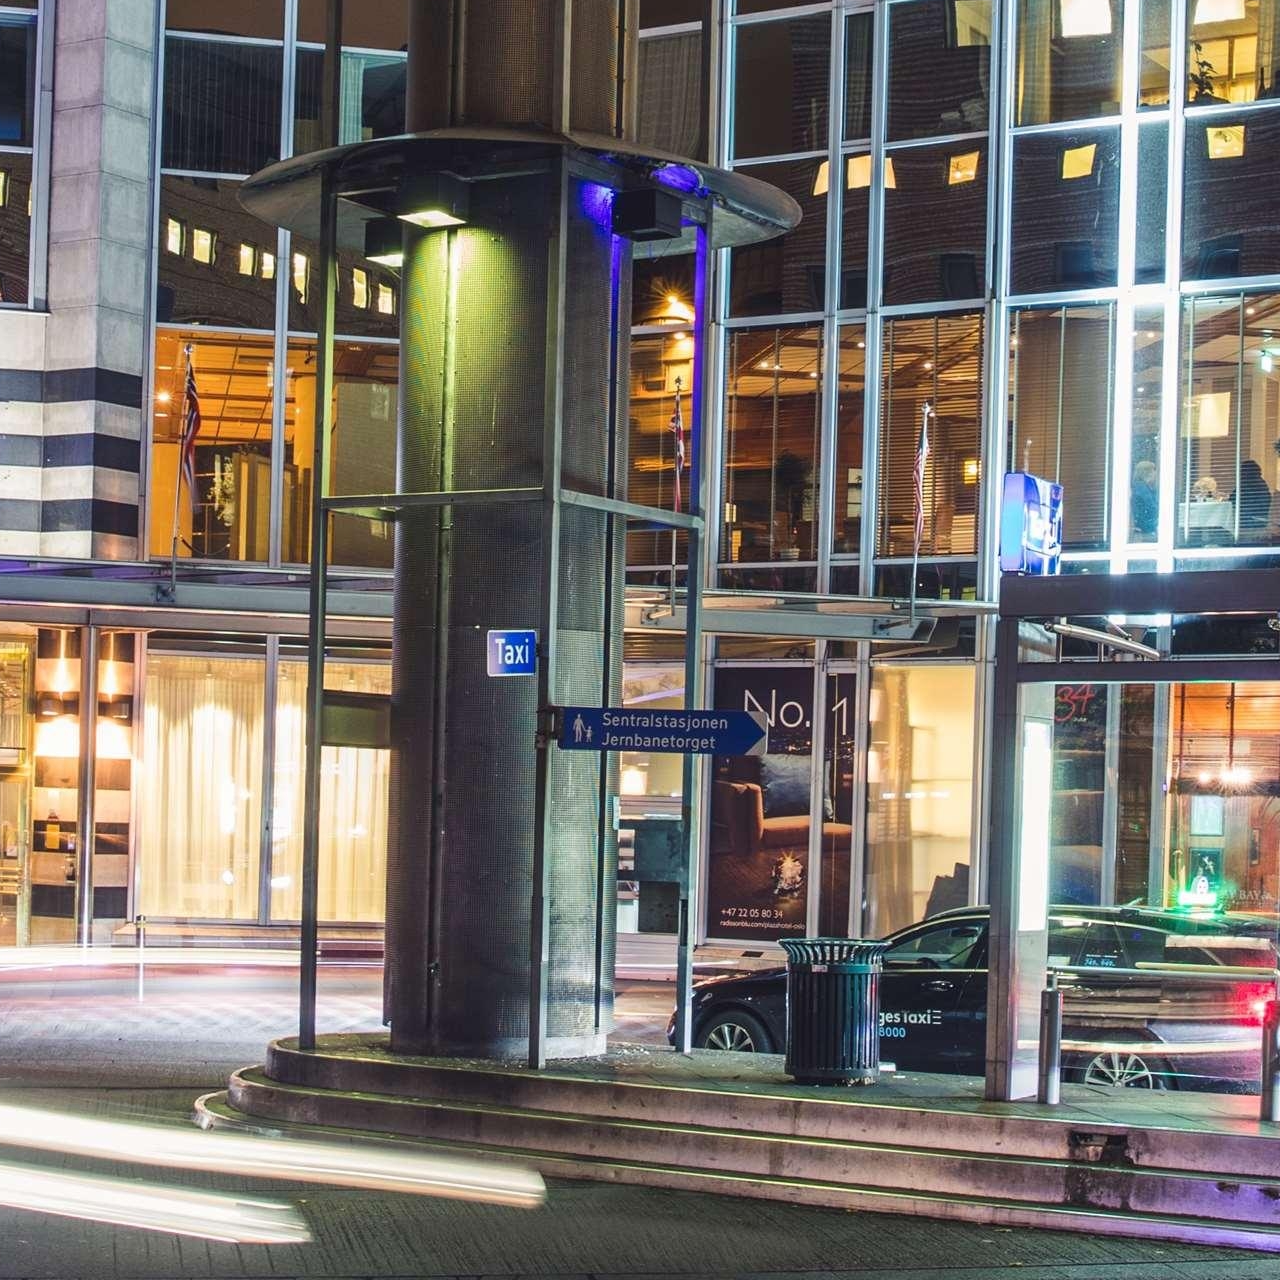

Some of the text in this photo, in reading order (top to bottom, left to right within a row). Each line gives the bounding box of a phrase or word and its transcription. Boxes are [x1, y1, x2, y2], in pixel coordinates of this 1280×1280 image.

[495, 638, 529, 665] Taxi
[602, 712, 728, 732] Sentralstasjonen
[744, 689, 848, 736] No. 1
[602, 732, 716, 751] Jernbanetorget
[721, 907, 784, 919] +47 22 05 80 34
